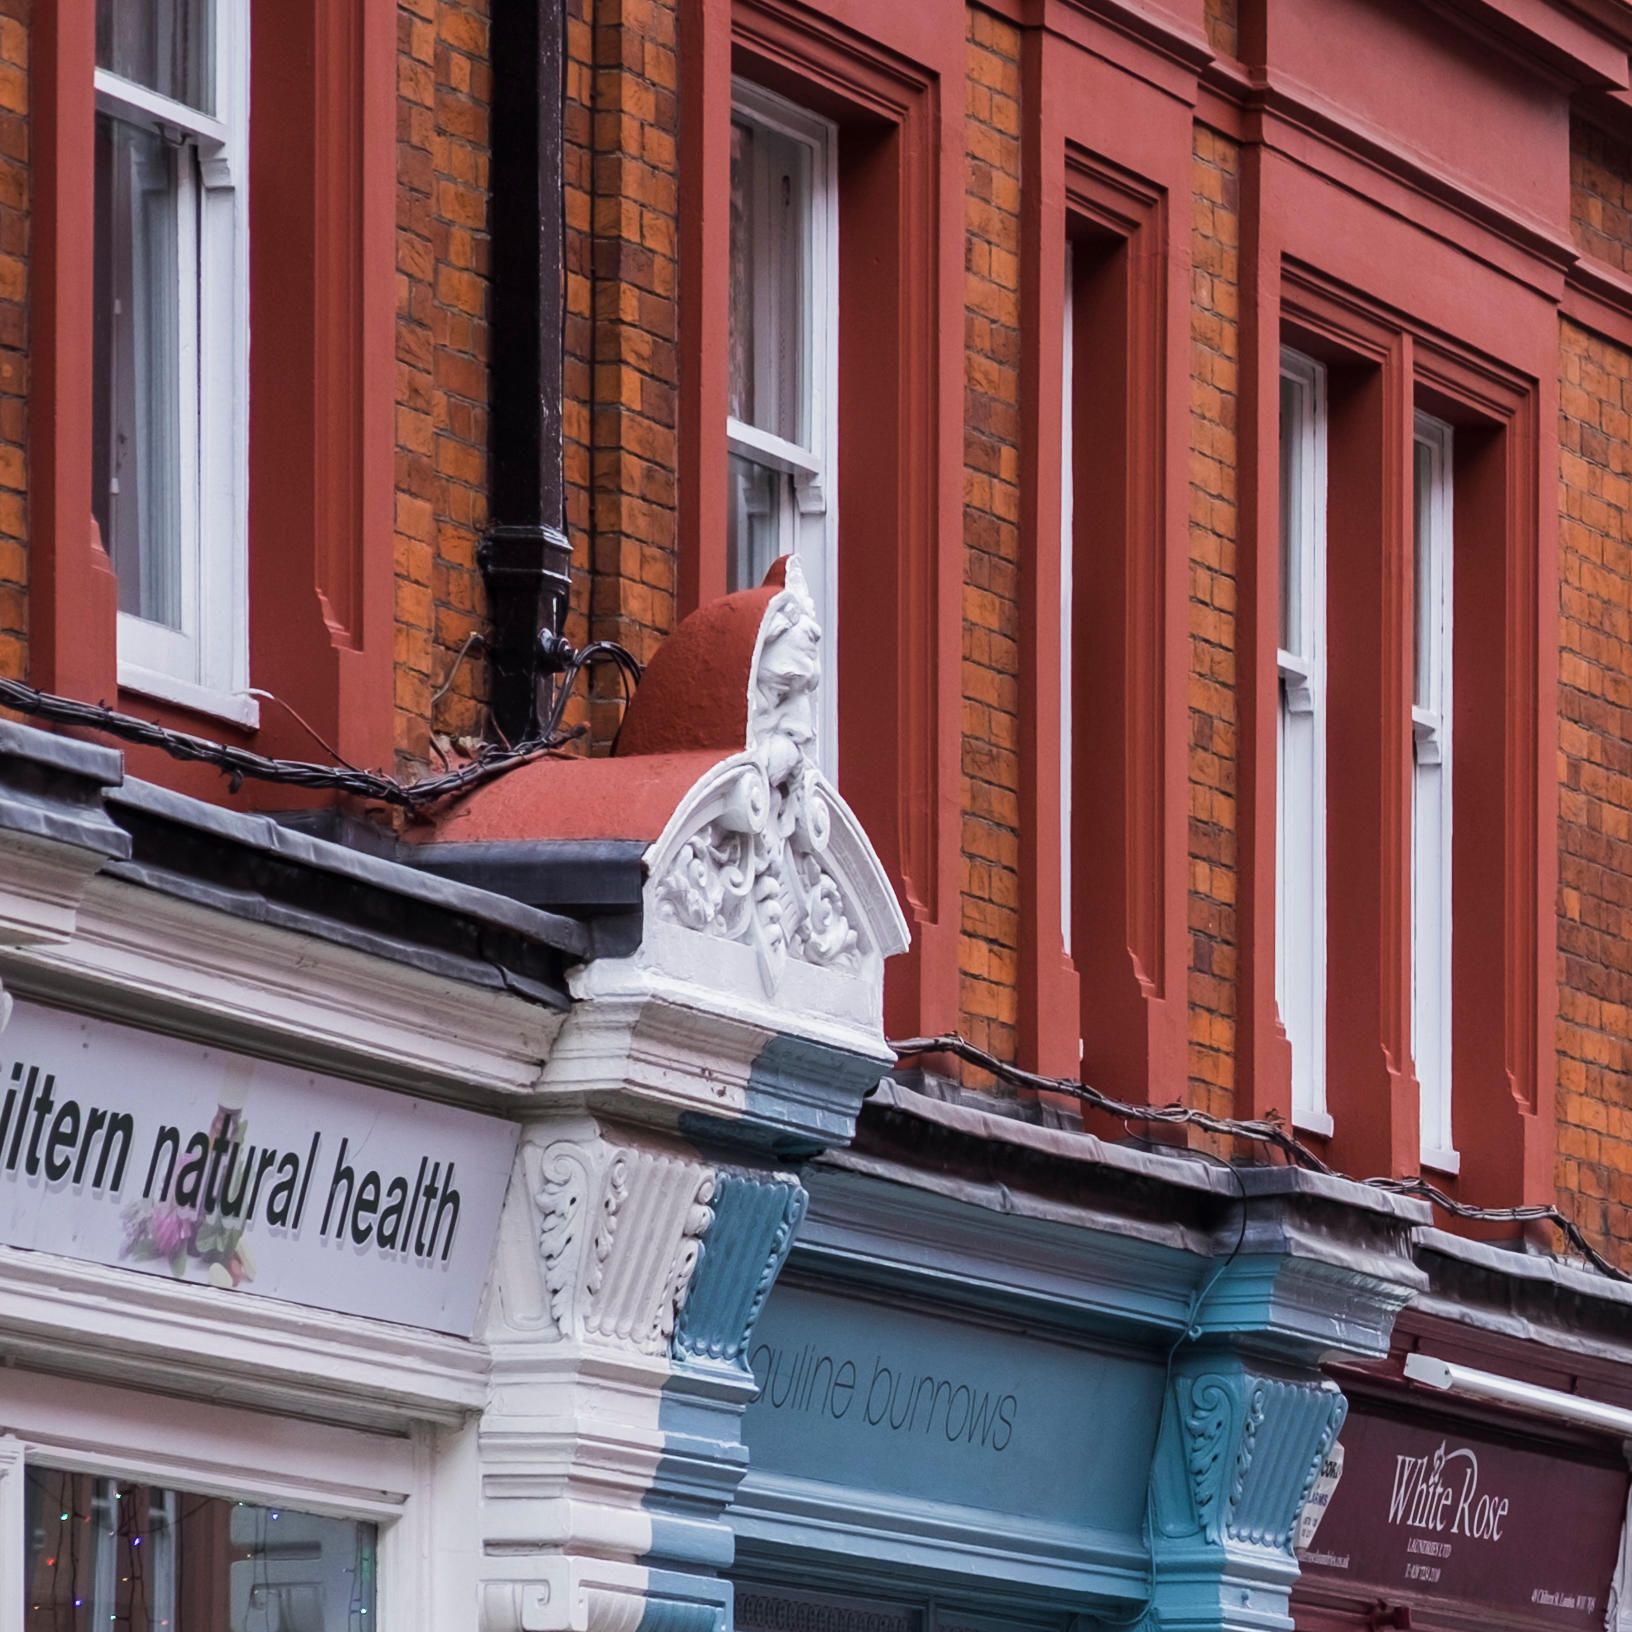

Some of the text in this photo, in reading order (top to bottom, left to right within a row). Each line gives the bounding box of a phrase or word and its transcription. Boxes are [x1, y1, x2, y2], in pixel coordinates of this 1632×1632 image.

[0, 1062, 461, 1261] iltern natural health
[863, 1354, 1017, 1452] burrows
[1388, 1454, 1452, 1531] White
[1451, 1448, 1509, 1542] Rose
